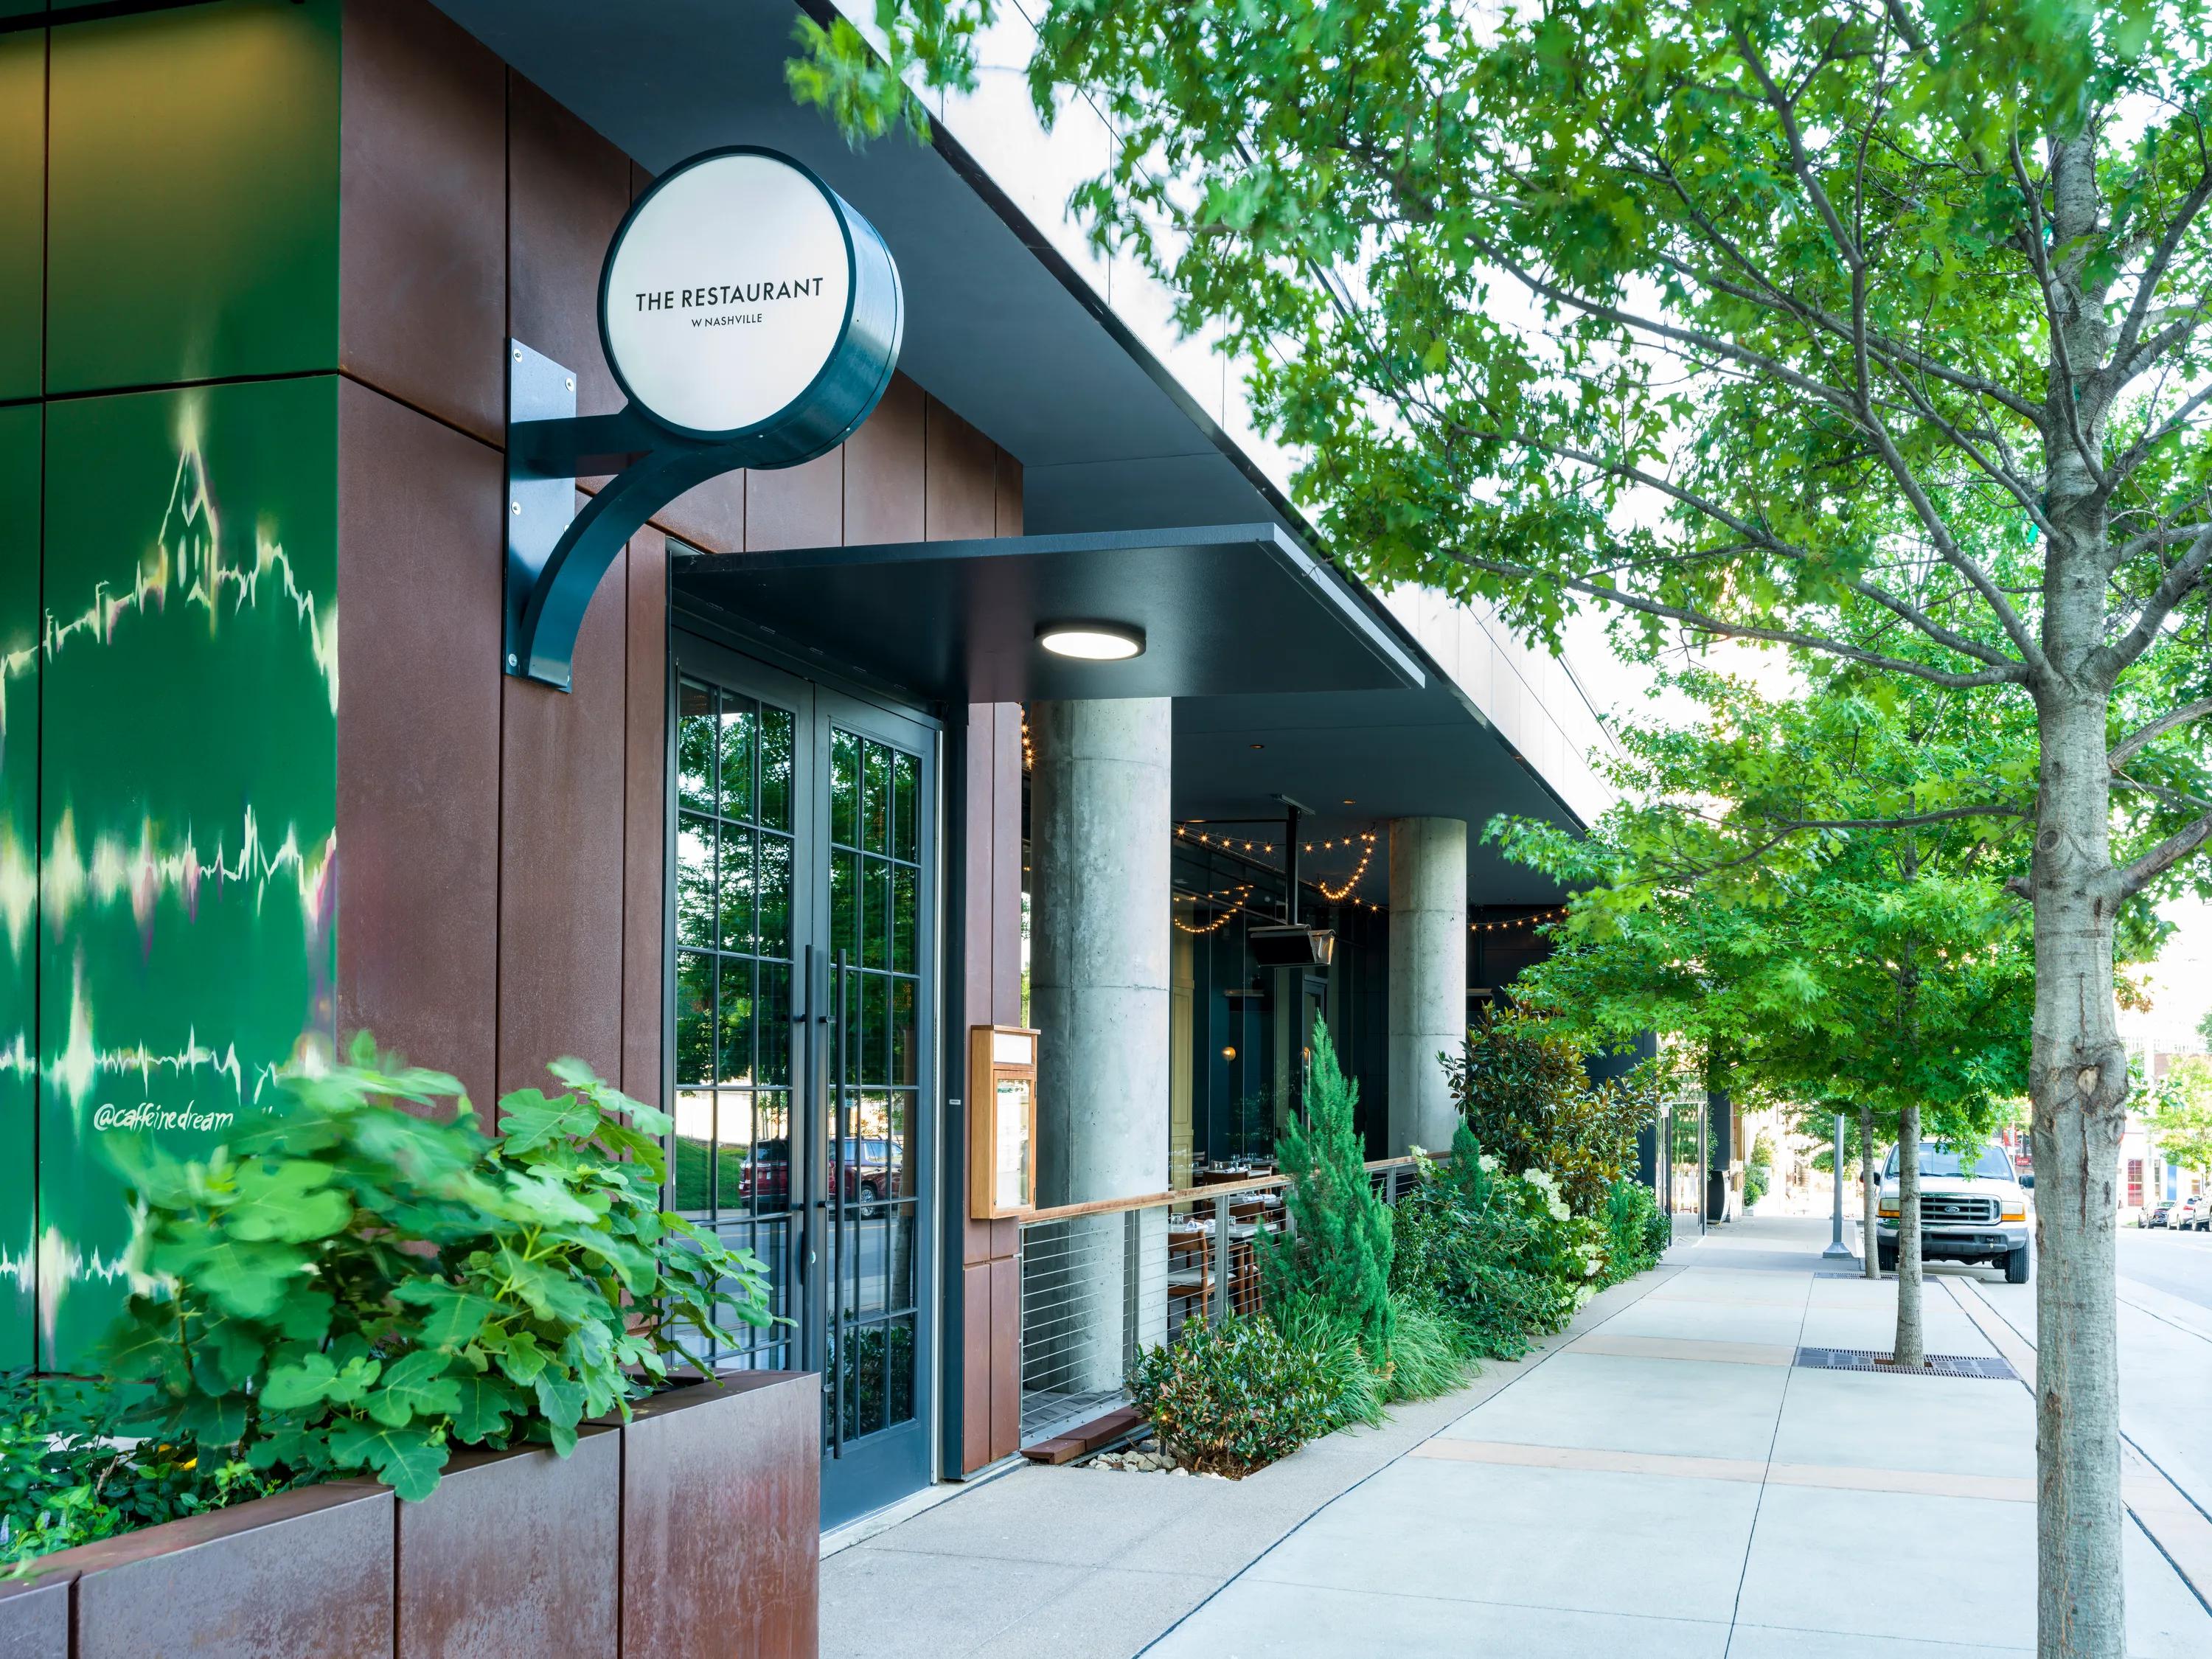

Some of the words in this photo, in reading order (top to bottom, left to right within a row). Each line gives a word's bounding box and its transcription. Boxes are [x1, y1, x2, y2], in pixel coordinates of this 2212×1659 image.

[636, 291, 675, 311] THE
[681, 277, 824, 308] RESTAURANT
[691, 319, 702, 327] W
[705, 313, 762, 327] NASHVILLE
